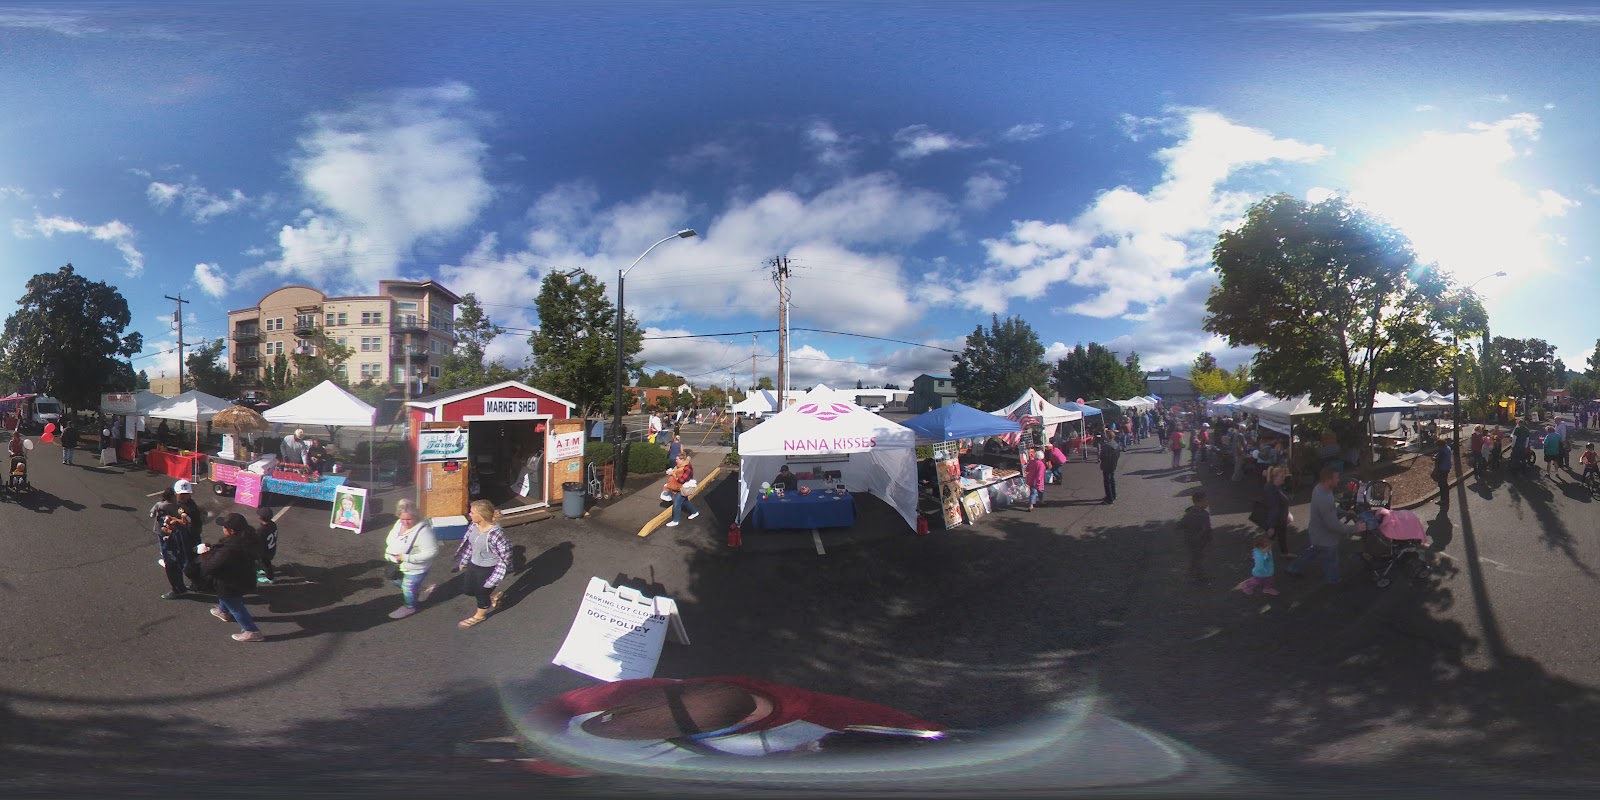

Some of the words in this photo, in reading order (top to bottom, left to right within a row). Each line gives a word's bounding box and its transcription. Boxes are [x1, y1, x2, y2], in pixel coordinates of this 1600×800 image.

[486, 401, 517, 412] MARKET
[518, 401, 536, 412] SHED
[783, 438, 828, 451] NANA
[833, 436, 877, 450] KISSES
[585, 592, 615, 607] PARKING
[616, 604, 631, 612] LOT
[633, 609, 666, 621] CLOSED
[587, 609, 607, 621] DOG
[610, 618, 650, 634] POLICY
